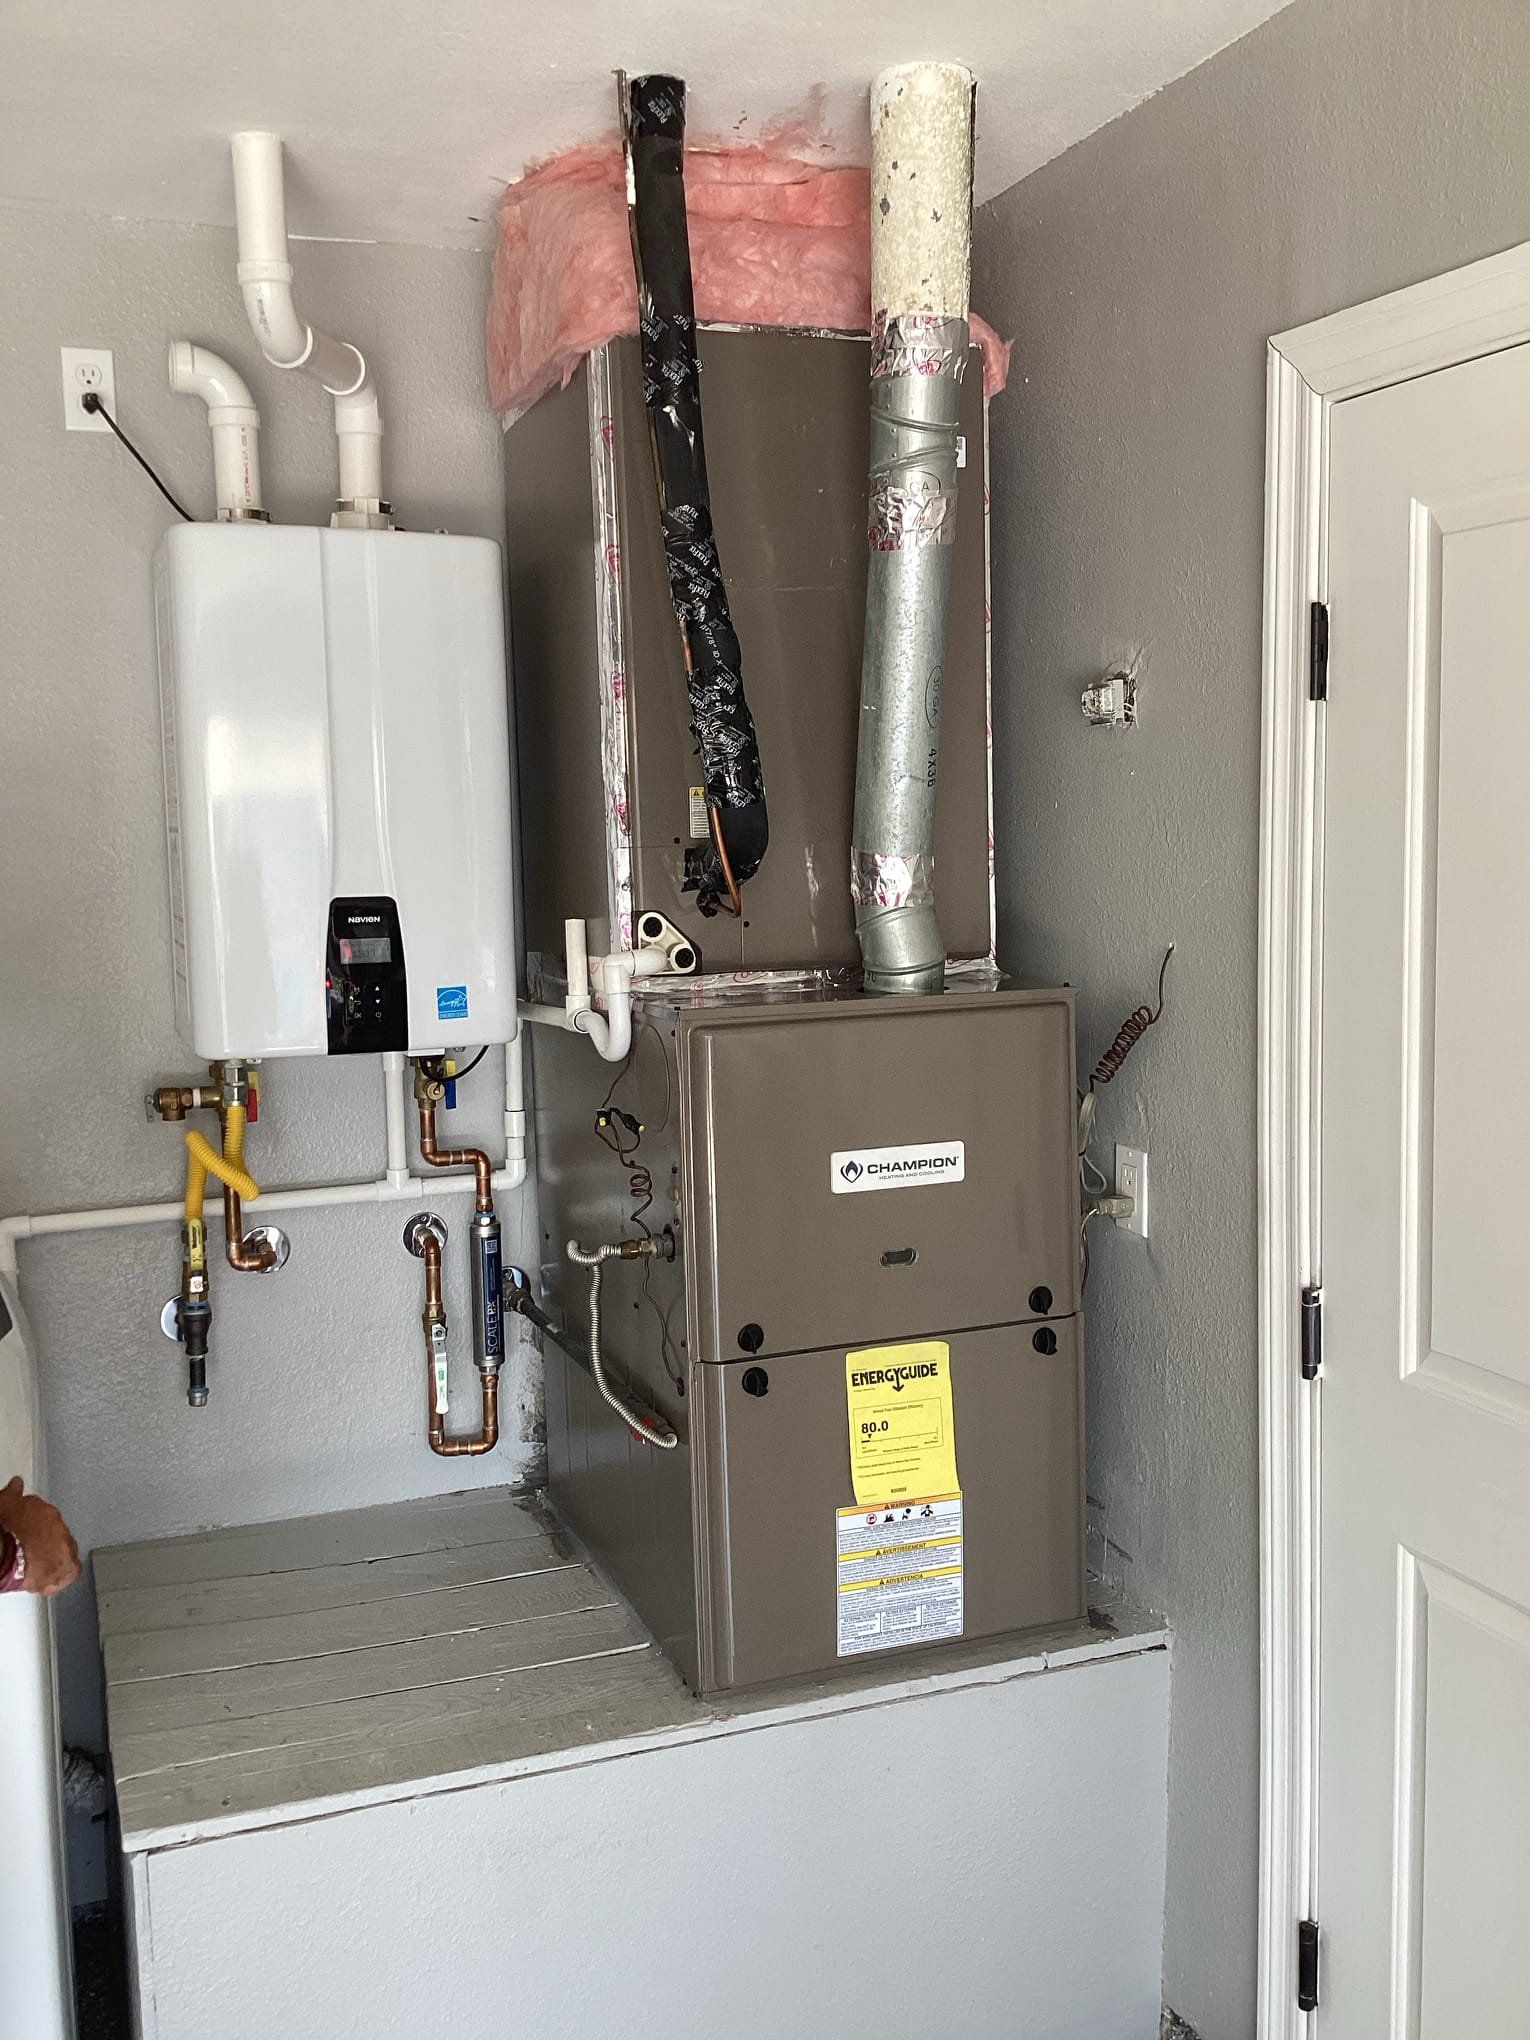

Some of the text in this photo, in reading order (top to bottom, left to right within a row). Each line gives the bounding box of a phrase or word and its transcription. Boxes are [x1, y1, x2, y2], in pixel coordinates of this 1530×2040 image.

[867, 1156, 957, 1174] CHAMPION
[918, 1169, 945, 1177] COOLING
[851, 1363, 938, 1388] ENERGYGUIDE
[861, 1421, 889, 1434] 80.0
